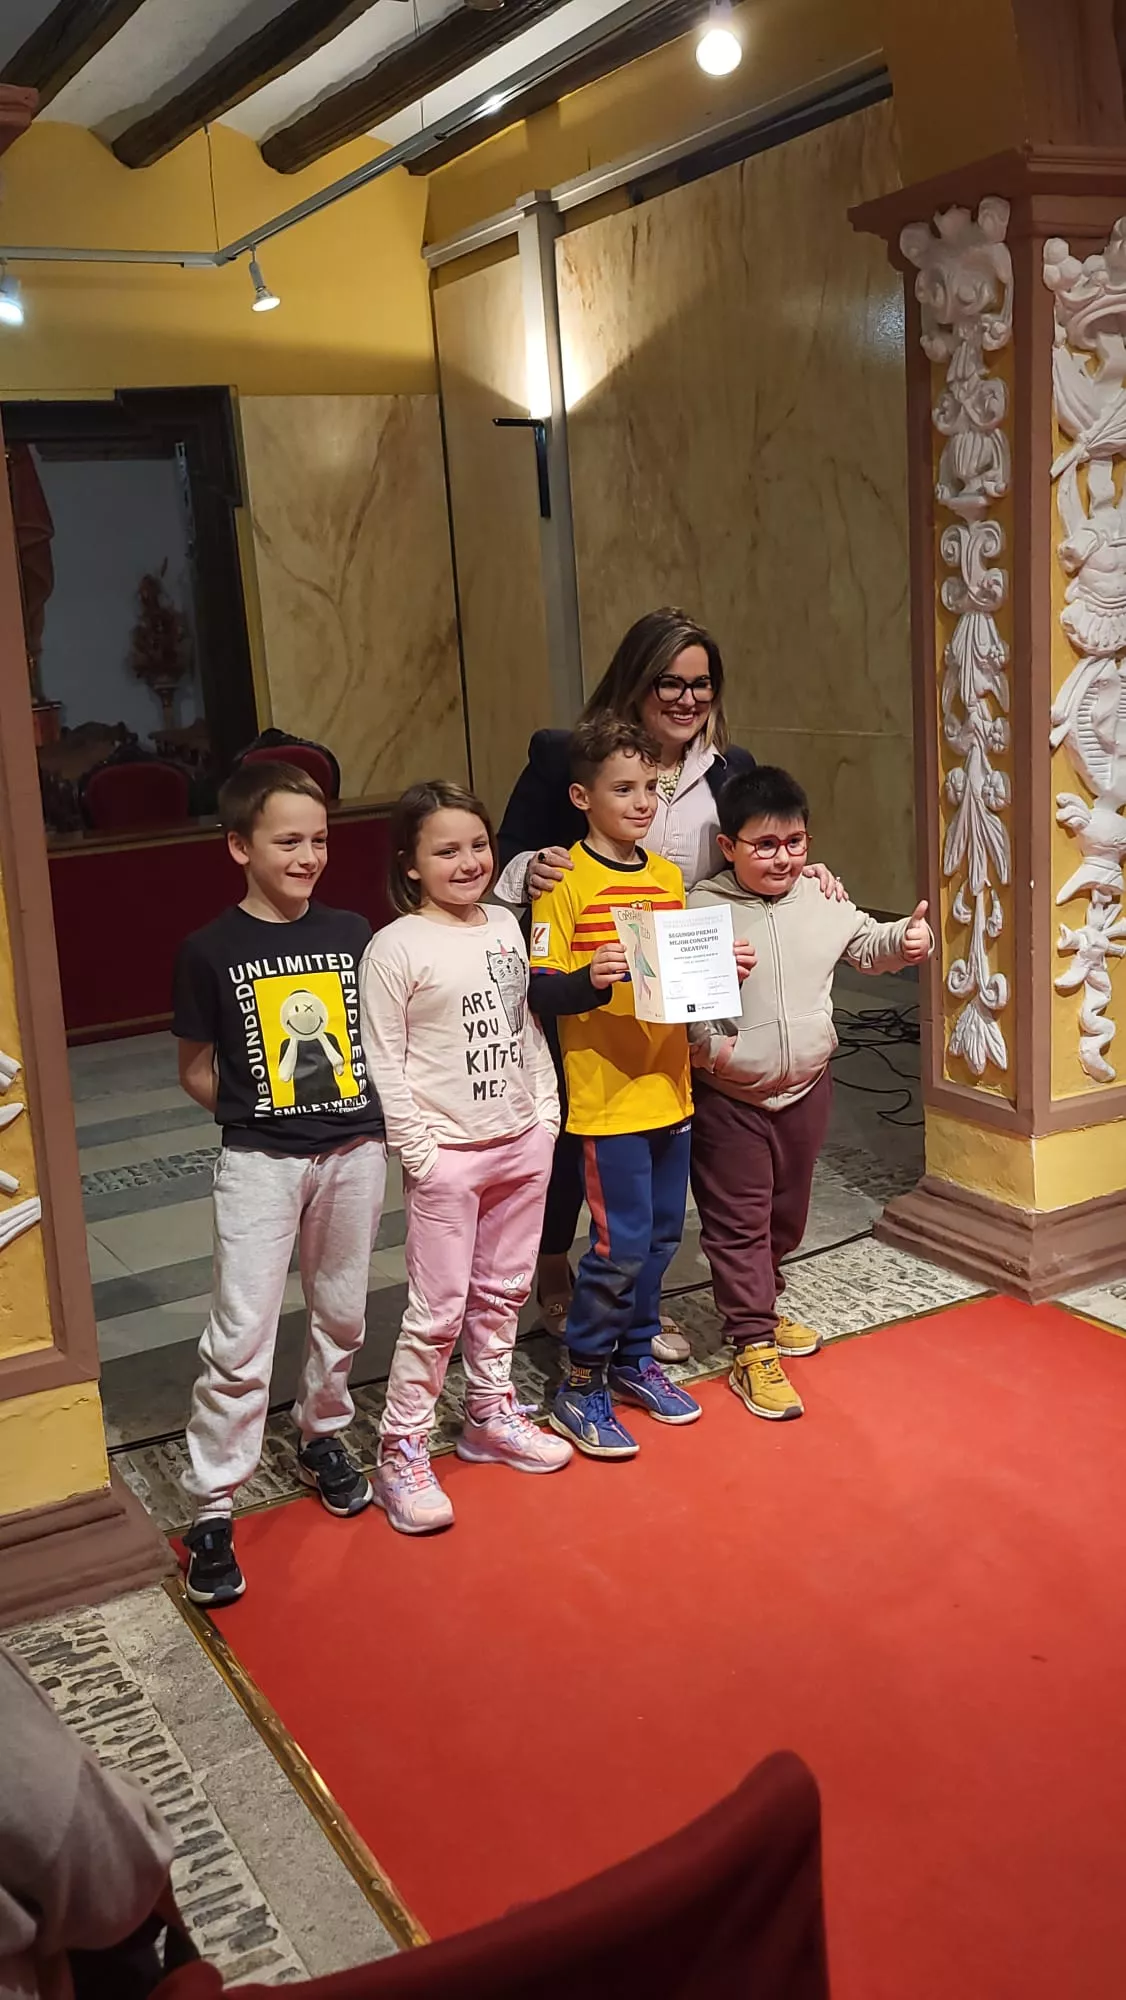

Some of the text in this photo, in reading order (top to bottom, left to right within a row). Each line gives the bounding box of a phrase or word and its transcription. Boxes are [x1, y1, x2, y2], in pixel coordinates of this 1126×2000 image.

[668, 928, 718, 939] SEGUNDO PREMIO
[669, 936, 719, 946] MEJOR CONCEPTO
[680, 945, 709, 953] CREATIVO
[228, 953, 354, 984] UNLIMITED
[462, 990, 496, 1016] ARE
[341, 970, 367, 1090] ENDLESS
[463, 1017, 499, 1042] YOU
[472, 1079, 507, 1100] ME?
